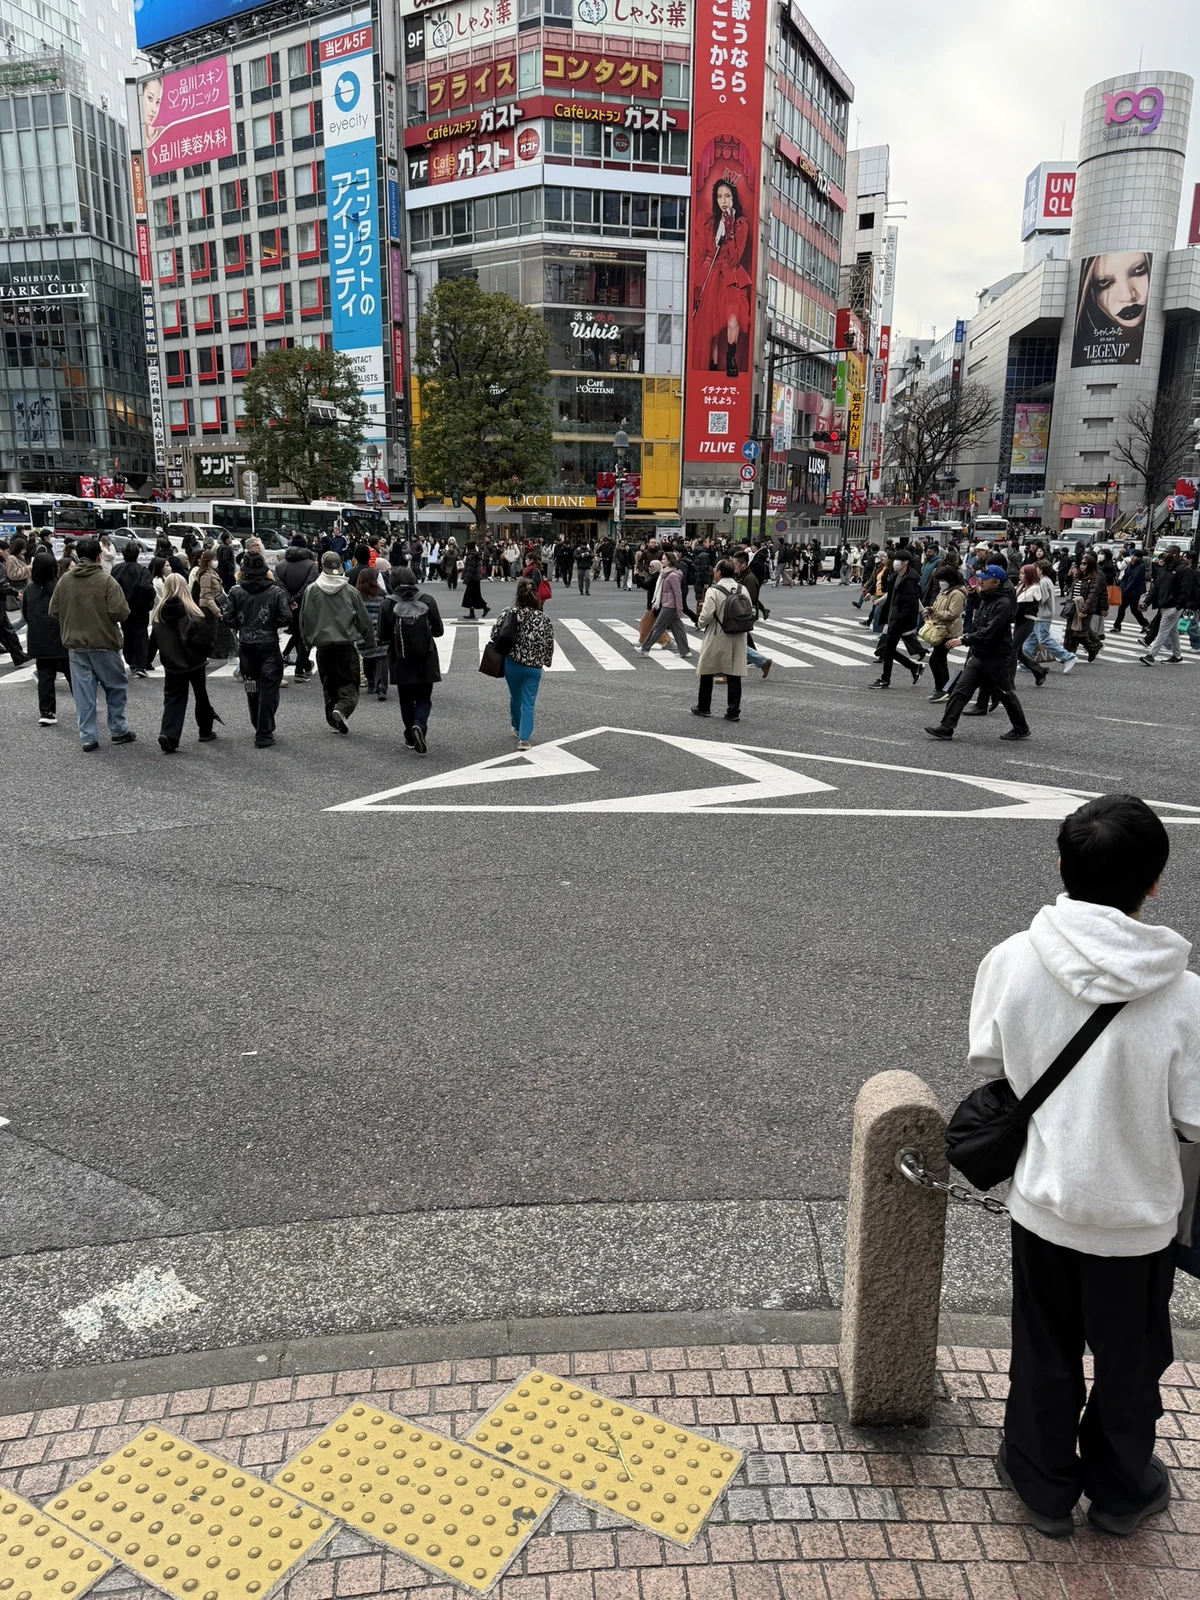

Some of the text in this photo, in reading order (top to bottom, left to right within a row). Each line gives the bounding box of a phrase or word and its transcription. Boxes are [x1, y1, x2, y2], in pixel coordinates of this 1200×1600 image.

[325, 30, 367, 57] 当ビル5F
[407, 30, 424, 49] 9F
[179, 68, 224, 96] 品川スキン
[429, 61, 515, 107] プライス
[544, 54, 660, 89] コンタクト
[180, 87, 220, 112] クリニック
[1102, 86, 1164, 135] 109
[329, 112, 369, 136] eyecity
[480, 103, 523, 134] ガスト
[624, 105, 677, 132] ガスト
[159, 126, 228, 164] 品川美容外科
[410, 159, 429, 180] 7F
[433, 140, 510, 178] Café ガスト
[1048, 196, 1073, 215] QL
[331, 171, 357, 318] アイシティ
[355, 167, 376, 315] コンタクトの
[13, 274, 60, 283] SHIBUYA
[47, 282, 89, 294] CITY
[569, 321, 620, 340] Ushi8
[851, 393, 861, 430] 処方せん
[808, 456, 826, 475] LUSH
